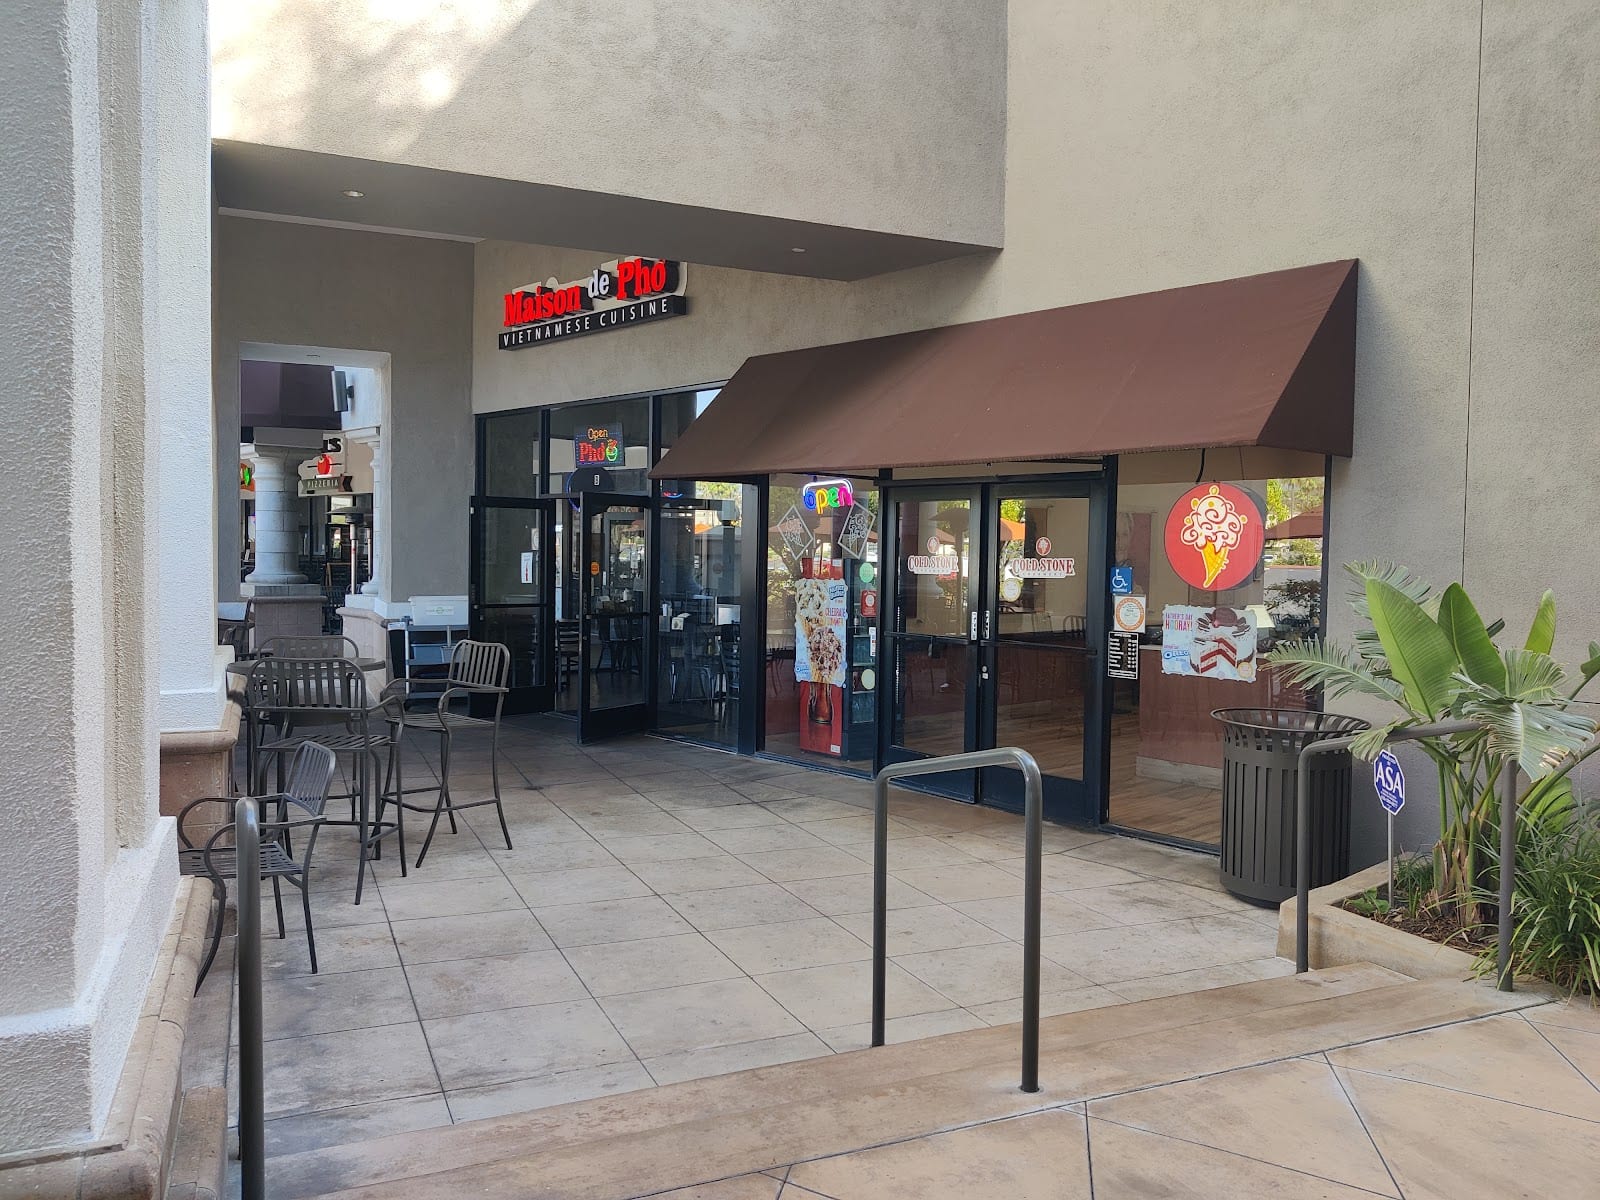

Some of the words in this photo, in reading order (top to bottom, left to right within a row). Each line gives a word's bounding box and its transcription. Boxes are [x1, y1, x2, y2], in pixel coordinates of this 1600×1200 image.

[504, 286, 581, 327] Maison
[588, 269, 610, 298] de
[503, 317, 590, 346] VIETNAMESE
[600, 299, 668, 327] CUISINE
[587, 428, 608, 441] Open
[307, 479, 339, 488] PIZZERIA
[908, 556, 929, 571] COLD
[930, 556, 958, 572] STONE
[1012, 558, 1039, 576] COLD
[1040, 558, 1074, 575] STONE
[1165, 619, 1193, 631] HOORAY!
[1376, 761, 1403, 799] ASA
